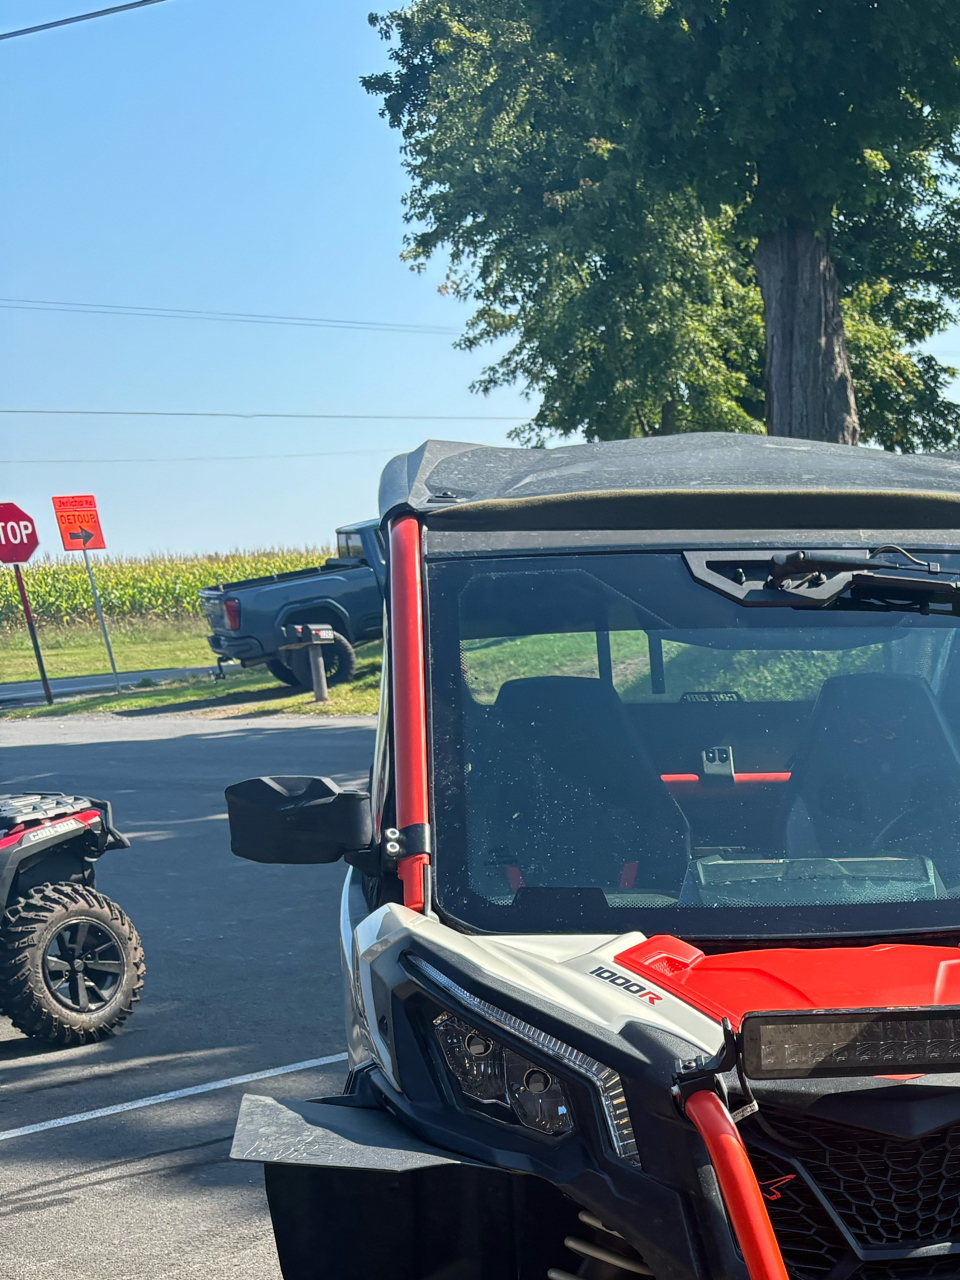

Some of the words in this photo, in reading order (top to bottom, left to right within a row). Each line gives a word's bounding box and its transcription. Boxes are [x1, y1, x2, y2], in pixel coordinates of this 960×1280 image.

[58, 499, 84, 508] Jericho
[60, 514, 97, 525] DETOUR
[0, 520, 33, 545] TOP
[589, 966, 663, 1006] 1000R
